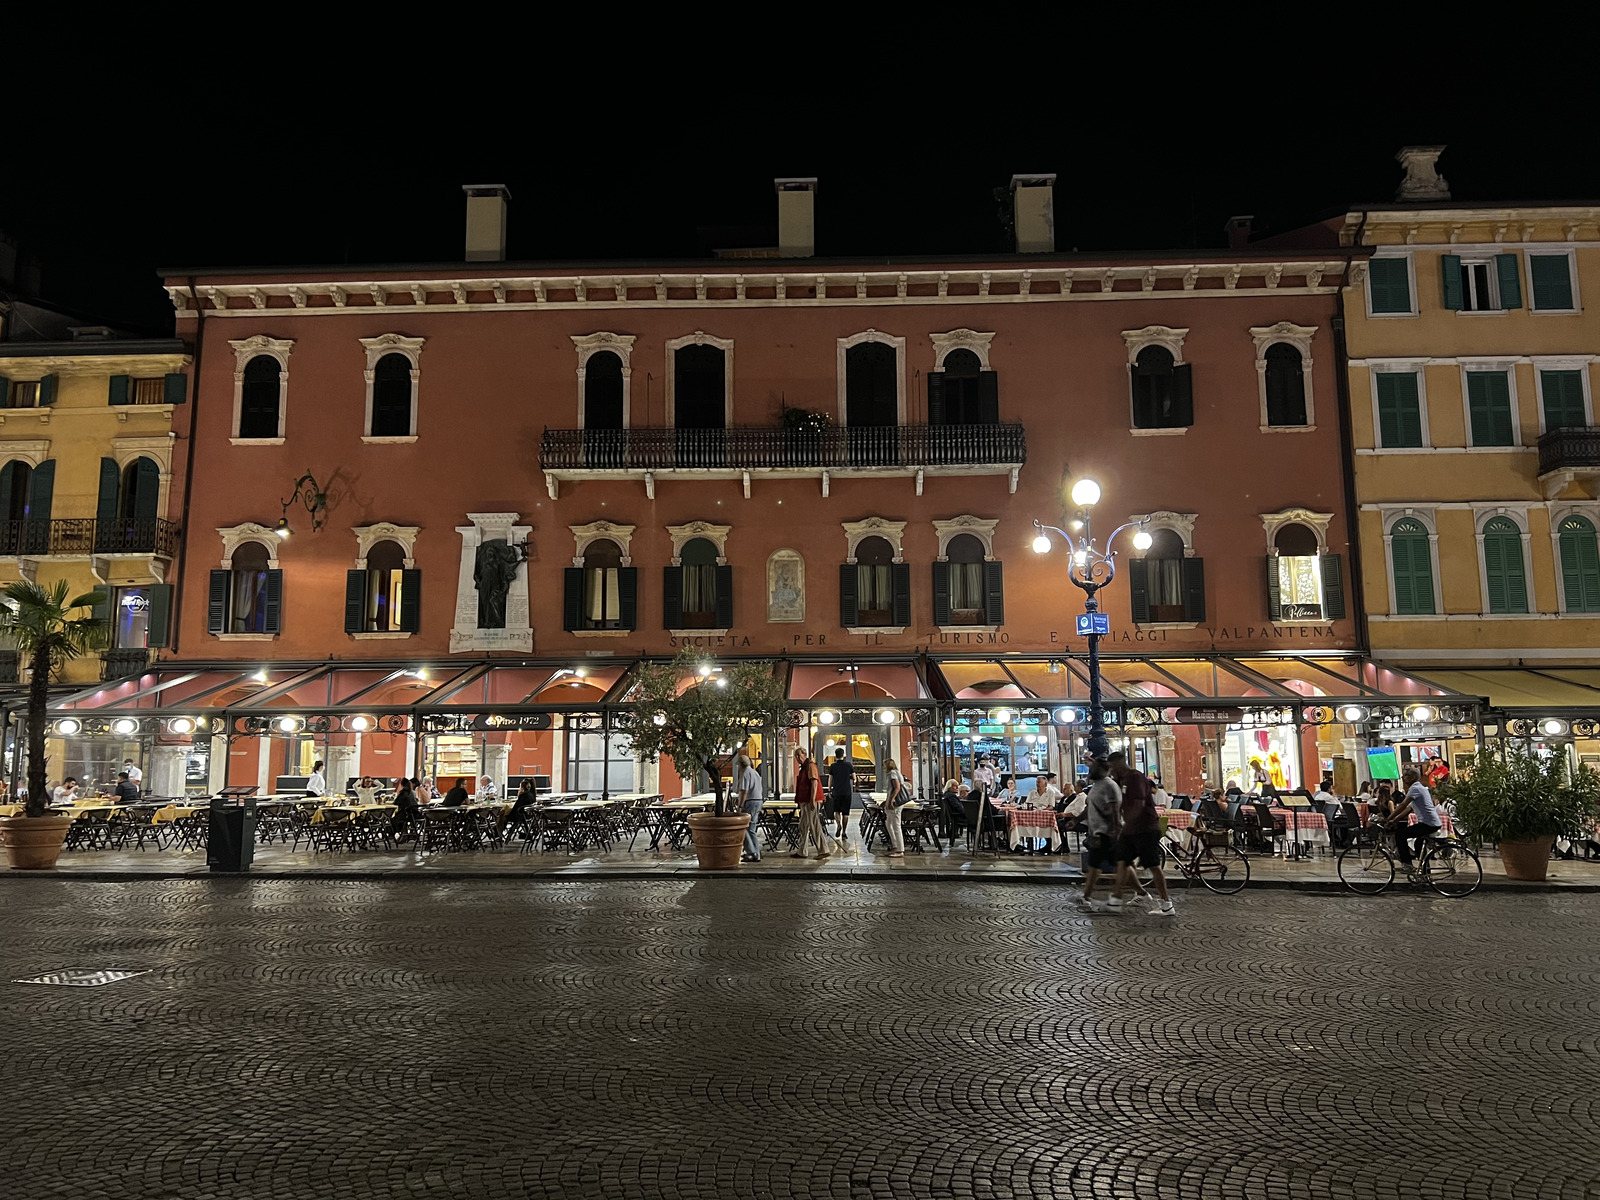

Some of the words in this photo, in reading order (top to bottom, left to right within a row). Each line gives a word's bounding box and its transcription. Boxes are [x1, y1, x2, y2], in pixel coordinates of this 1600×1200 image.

[793, 634, 827, 646] PER
[865, 634, 884, 645] IL
[926, 632, 1010, 645] TURISMO
[1050, 631, 1058, 643] E
[1207, 625, 1335, 639] VALPANTENA
[519, 716, 540, 725] 1972
